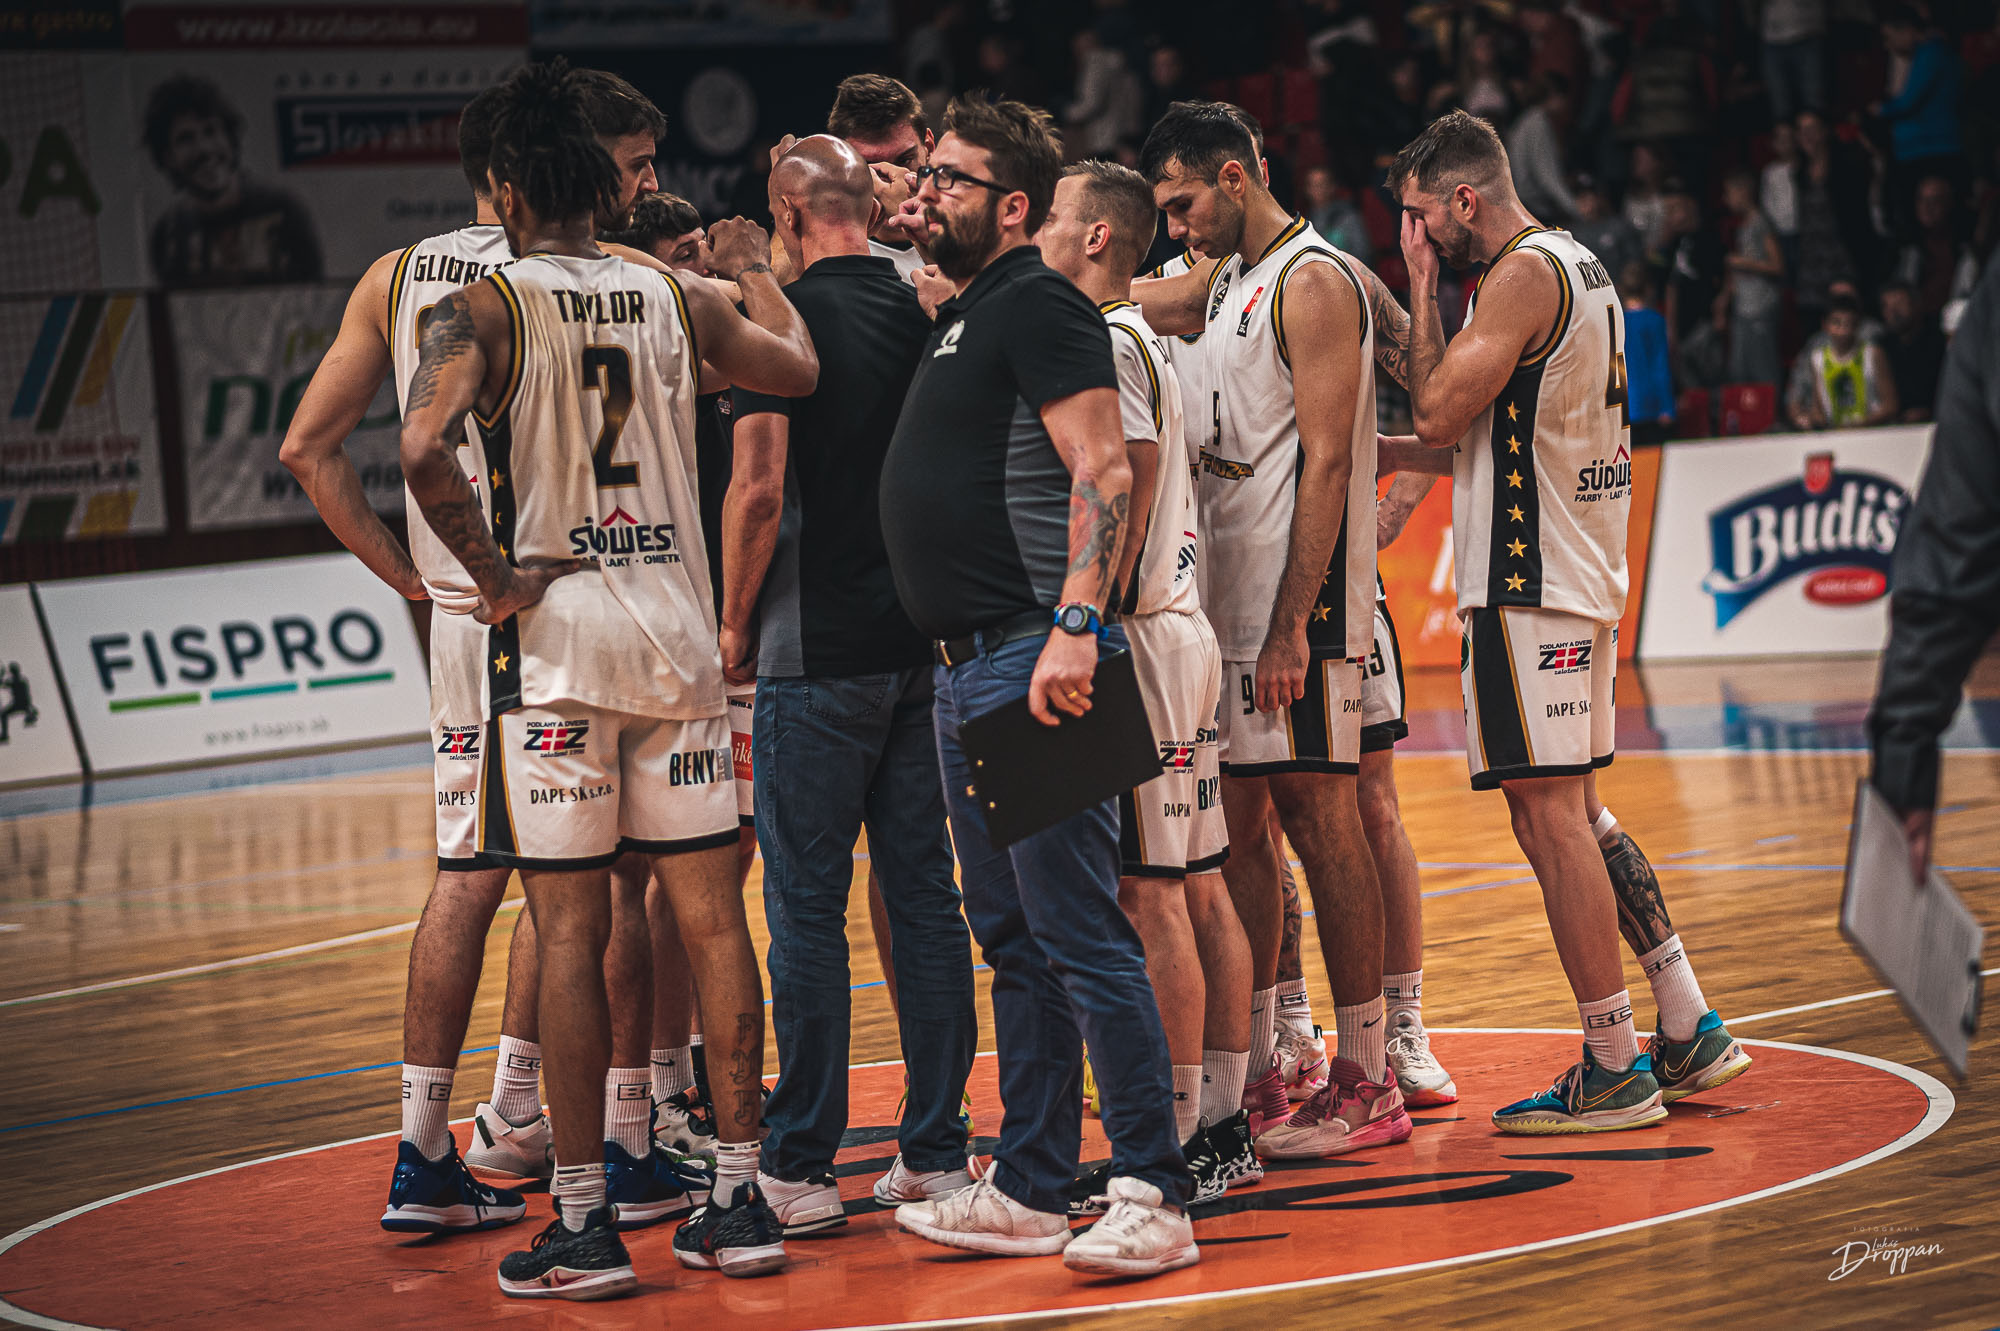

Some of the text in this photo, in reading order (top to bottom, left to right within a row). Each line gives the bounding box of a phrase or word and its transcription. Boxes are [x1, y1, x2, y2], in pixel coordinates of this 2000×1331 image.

[552, 289, 645, 324] TAYLOR
[1605, 304, 1631, 429] 4
[582, 343, 640, 489] 2
[1575, 493, 1602, 502] FARBY
[89, 608, 385, 694] FISPRO
[1539, 642, 1568, 650] PODLAHY
[1241, 674, 1255, 715] 9
[1546, 702, 1576, 718] DAPE
[670, 749, 715, 787] BENY
[438, 791, 466, 806] DAPE
[531, 784, 615, 804] DAPE SK s.r.o.
